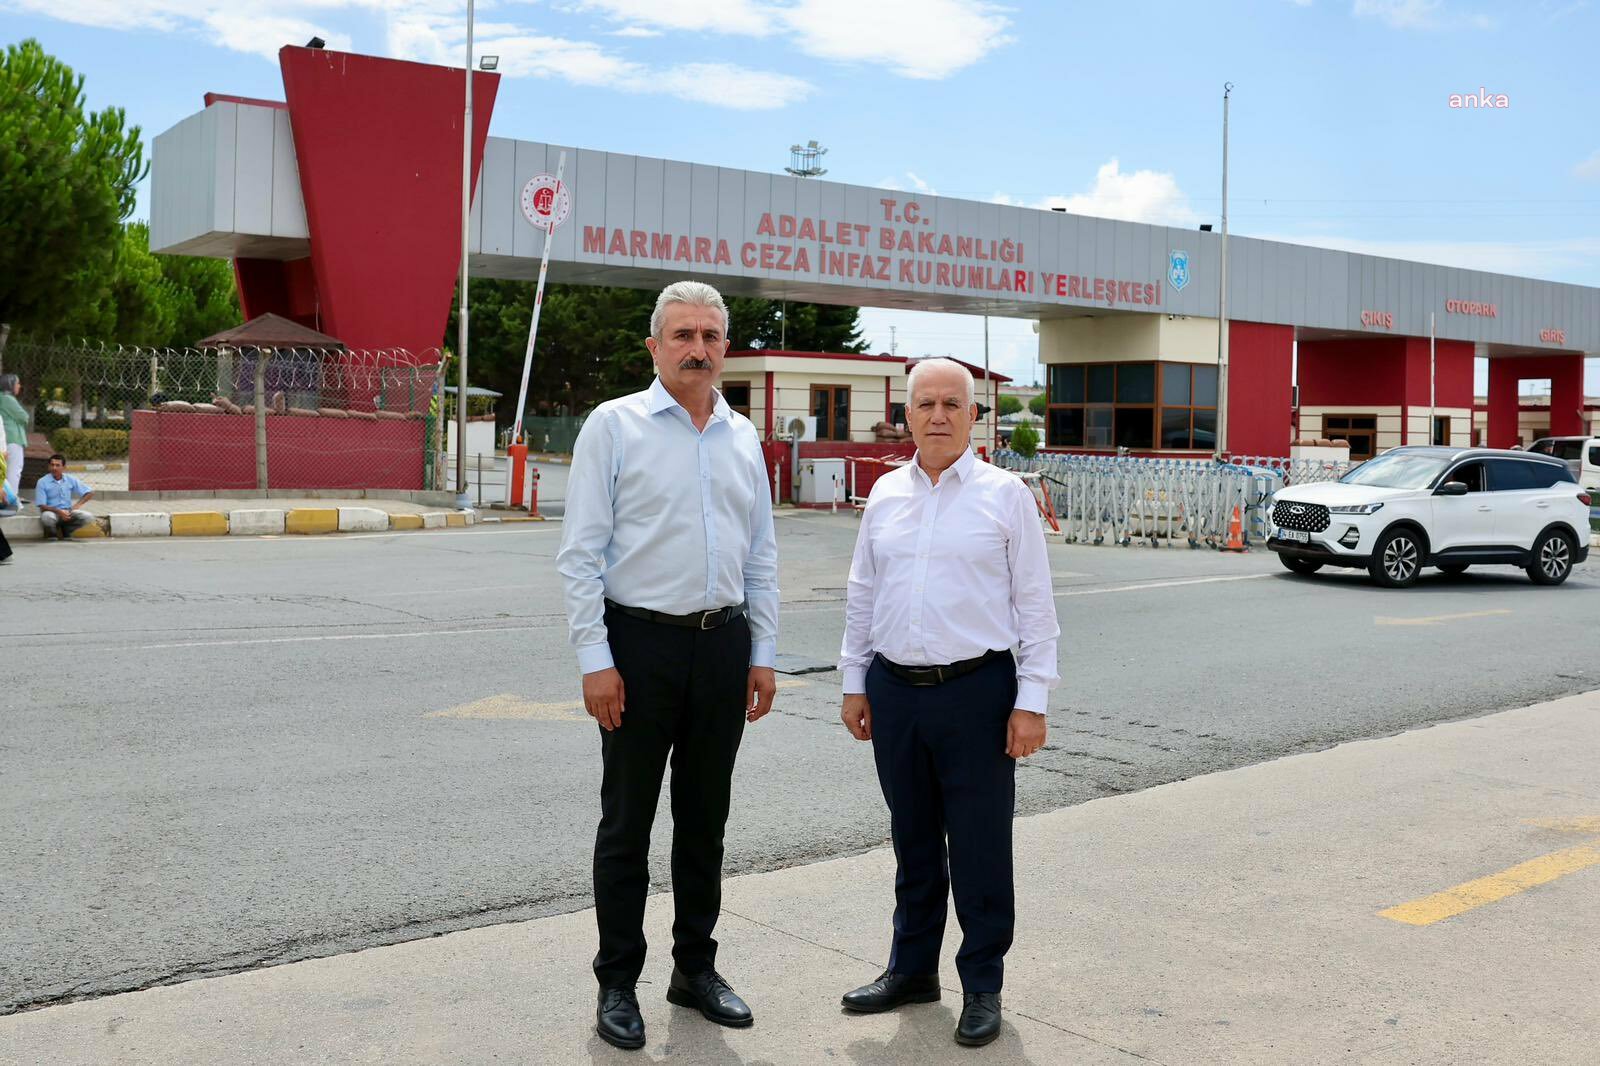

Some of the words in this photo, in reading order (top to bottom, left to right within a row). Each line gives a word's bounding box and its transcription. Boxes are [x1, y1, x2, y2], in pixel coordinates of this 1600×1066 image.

[880, 198, 929, 225] T.C.
[756, 212, 870, 247] ADALET
[879, 227, 1024, 264] BAKANLIĞI
[583, 226, 732, 265] MARMARA
[740, 242, 810, 272] CEZA
[819, 243, 891, 281] İNFAZ
[900, 255, 1034, 294] KURUMLARI
[1041, 272, 1161, 306] YERLEŞKESİ
[1446, 299, 1497, 317] OTOPARK
